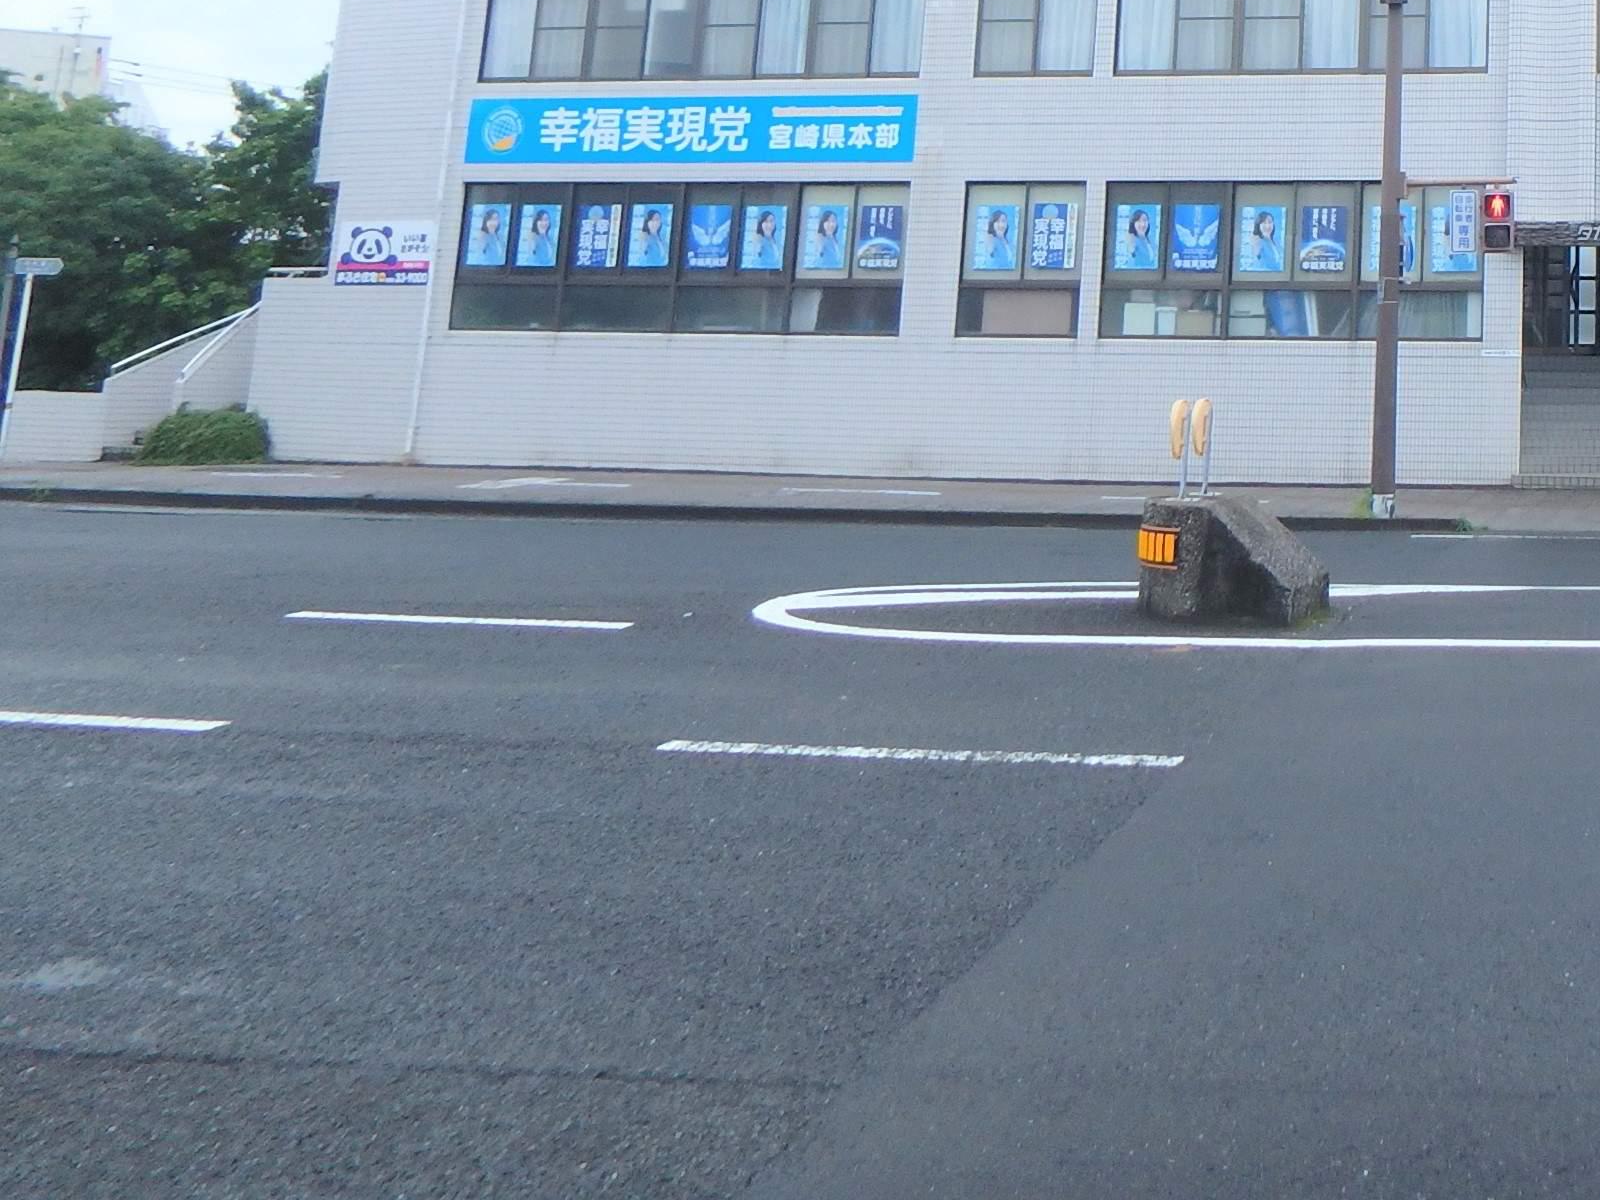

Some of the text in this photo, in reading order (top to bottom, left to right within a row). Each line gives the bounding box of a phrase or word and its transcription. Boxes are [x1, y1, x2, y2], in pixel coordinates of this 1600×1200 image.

[539, 105, 752, 153] 幸福実現党
[768, 123, 901, 150] 宮崎県本部
